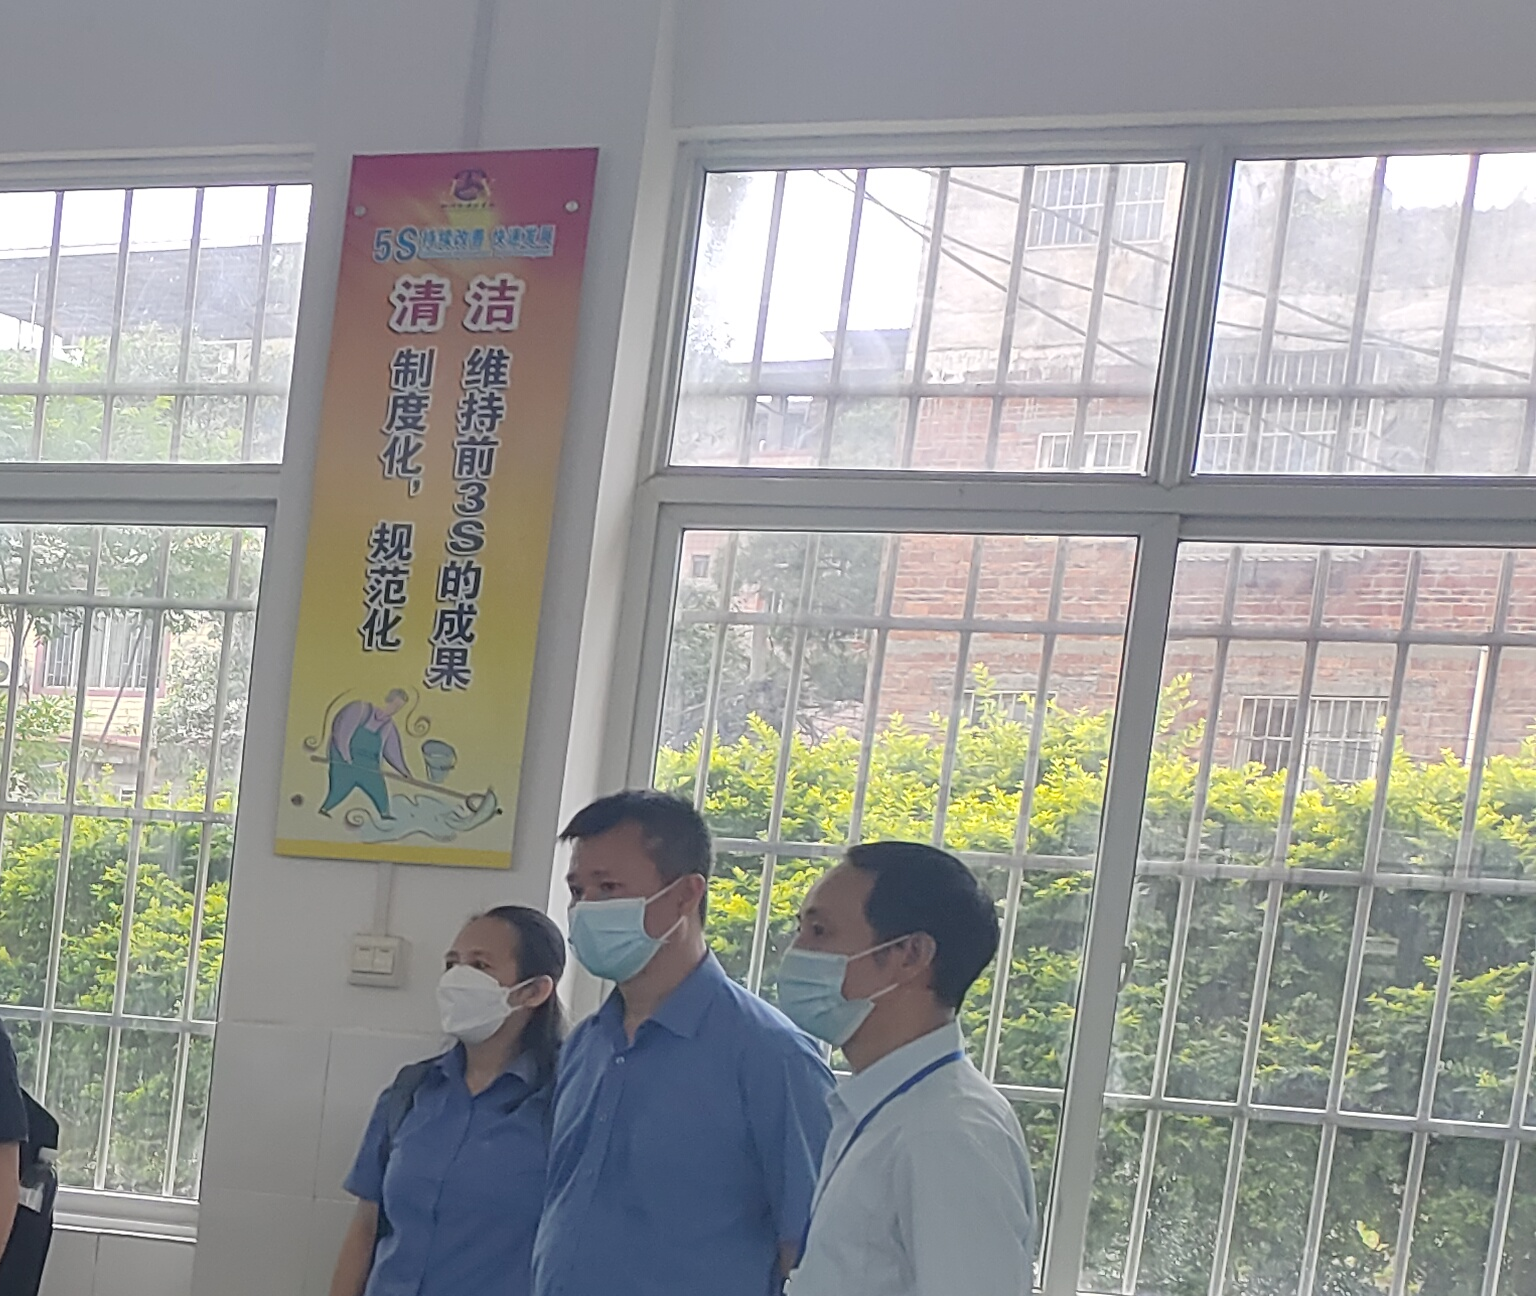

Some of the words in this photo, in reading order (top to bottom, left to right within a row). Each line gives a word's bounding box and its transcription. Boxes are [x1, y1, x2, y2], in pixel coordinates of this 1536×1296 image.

[427, 346, 511, 688] 维持前3S的成果
